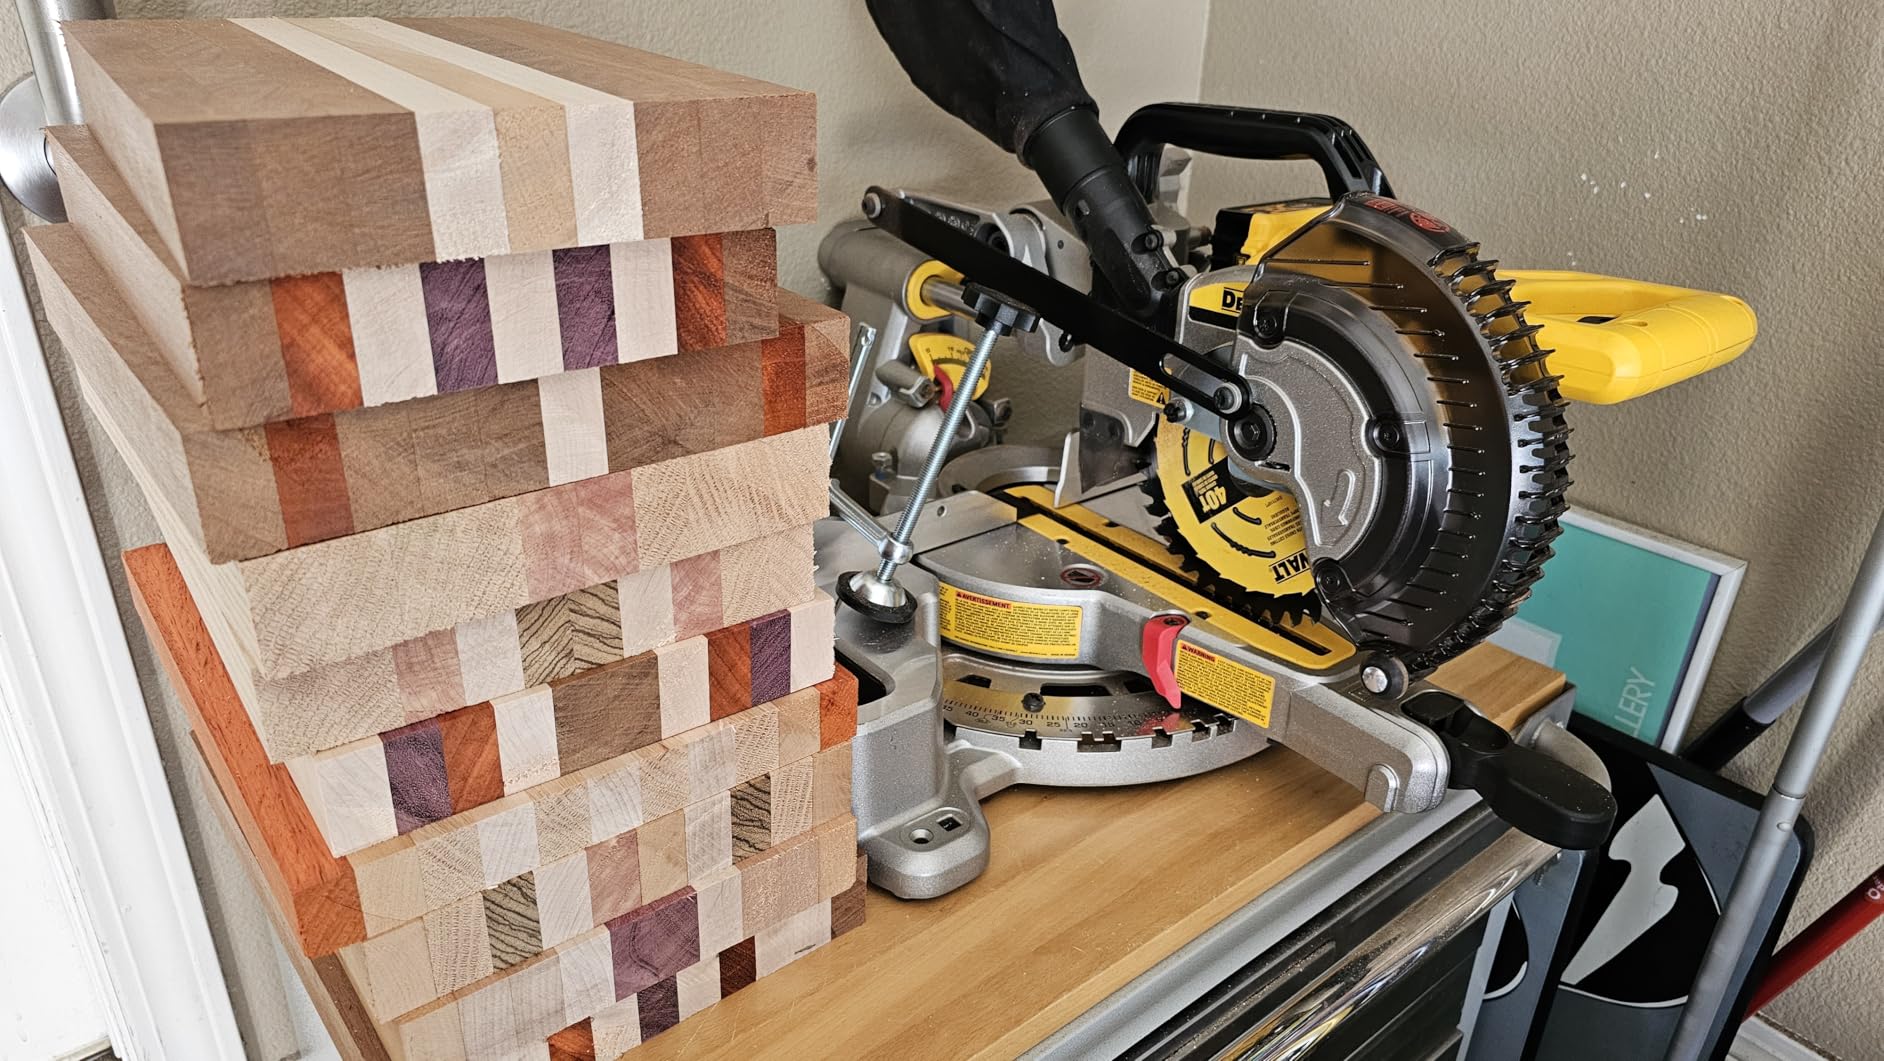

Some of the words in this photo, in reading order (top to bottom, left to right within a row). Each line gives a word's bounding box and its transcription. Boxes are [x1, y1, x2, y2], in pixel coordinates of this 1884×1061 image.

[1199, 486, 1227, 513] 40T
[962, 593, 1011, 610] AVERTISSEMENT
[1188, 647, 1215, 662] WARNING
